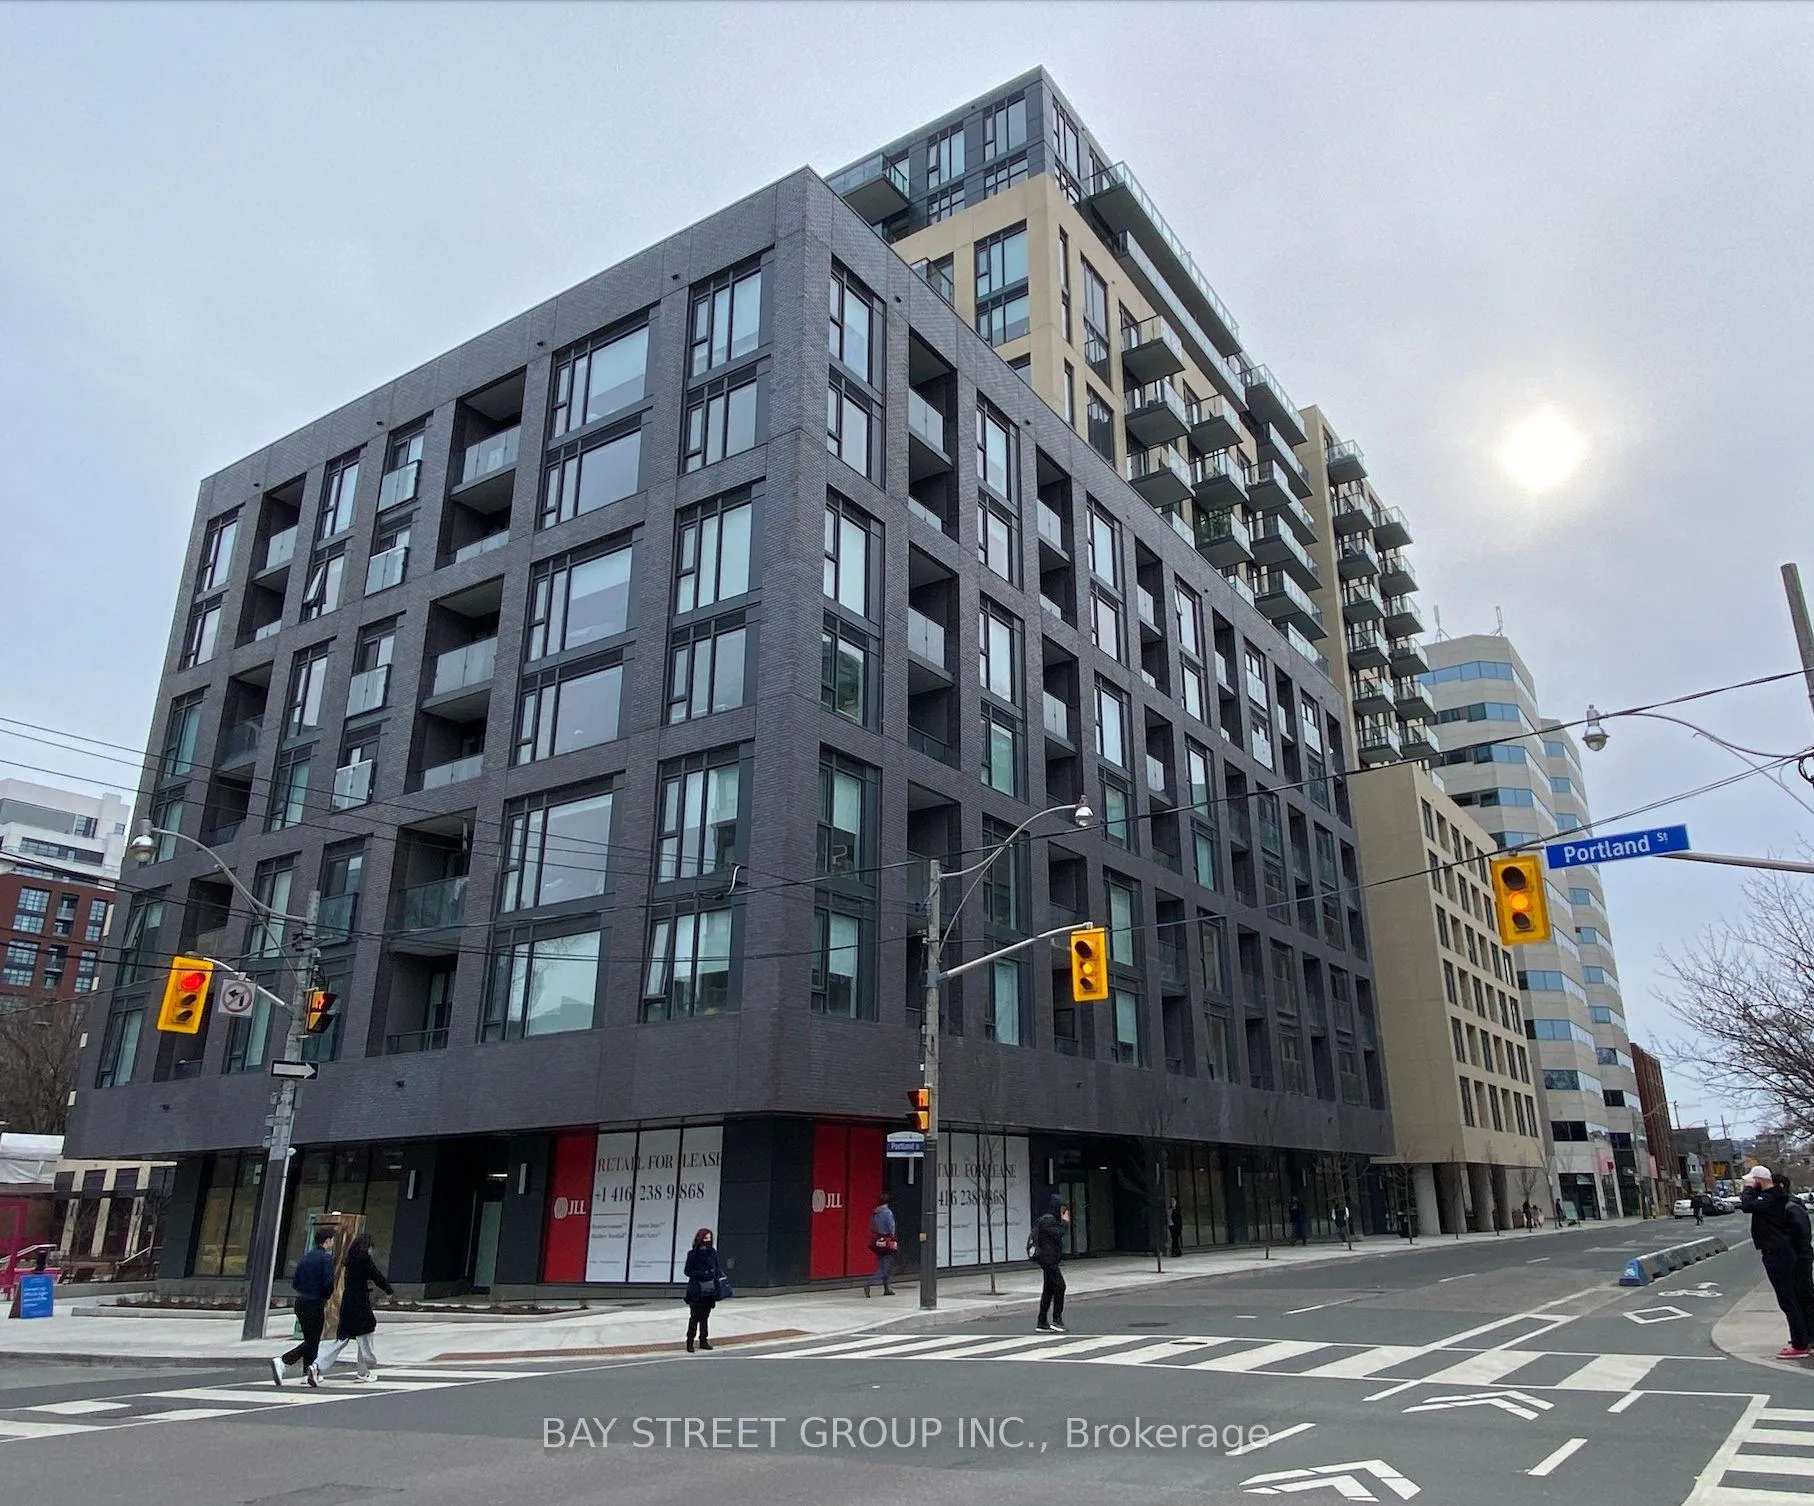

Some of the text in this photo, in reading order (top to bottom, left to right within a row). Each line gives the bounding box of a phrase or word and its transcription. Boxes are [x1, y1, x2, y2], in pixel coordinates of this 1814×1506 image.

[1563, 832, 1668, 864] Portland St
[890, 1141, 915, 1151] Portland
[597, 1155, 645, 1172] RETAIL
[648, 1154, 673, 1169] FOR
[595, 1182, 705, 1203] +1 416 238 9868
[825, 1192, 842, 1208] JLL
[568, 1200, 586, 1215] JLL
